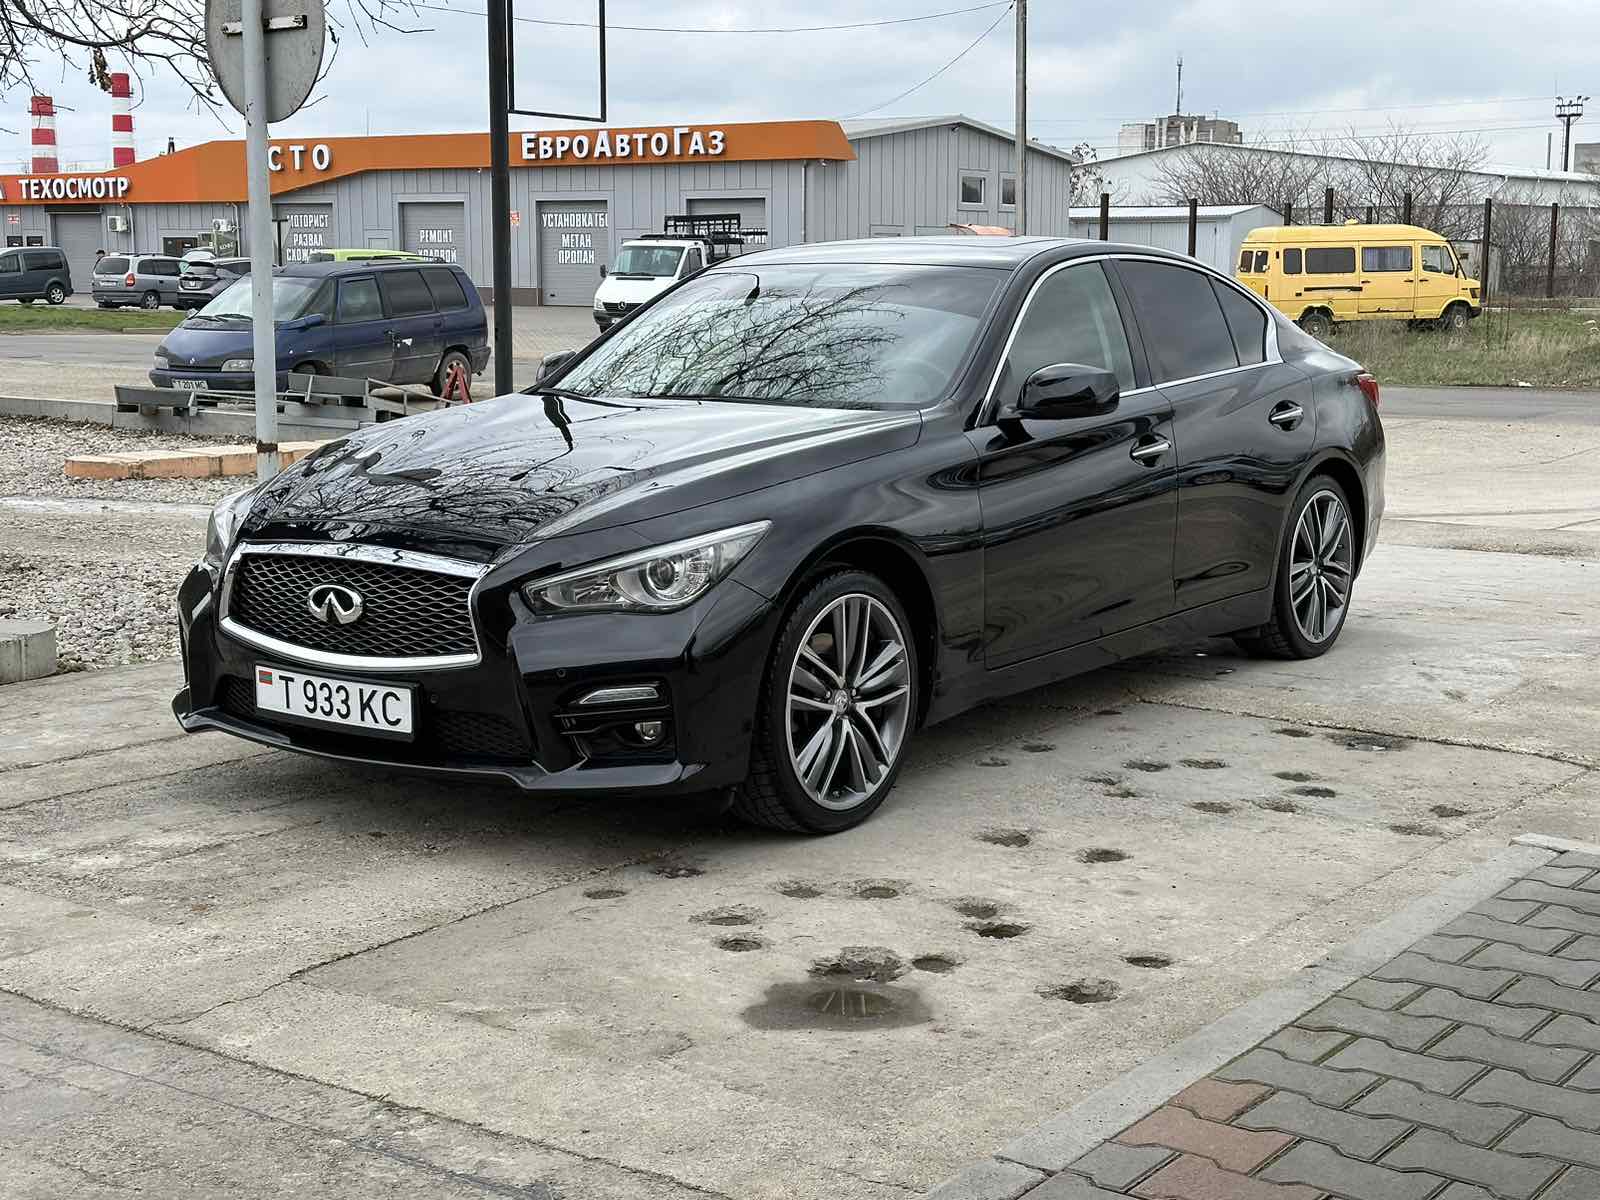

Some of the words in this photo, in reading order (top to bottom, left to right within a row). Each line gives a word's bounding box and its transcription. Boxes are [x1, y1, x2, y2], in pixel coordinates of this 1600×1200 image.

[267, 144, 330, 171] СТО
[18, 177, 129, 199] ТЕХОСМОТР
[542, 212, 593, 228] УСТАНОВКА
[293, 233, 324, 247] РАЗВАЛ
[420, 229, 453, 243] РЕМОНТ
[561, 233, 592, 248] МЕТАН
[558, 249, 595, 264] ПРОПАН
[279, 675, 295, 709] T
[303, 679, 351, 720] 933
[359, 687, 402, 726] KC
